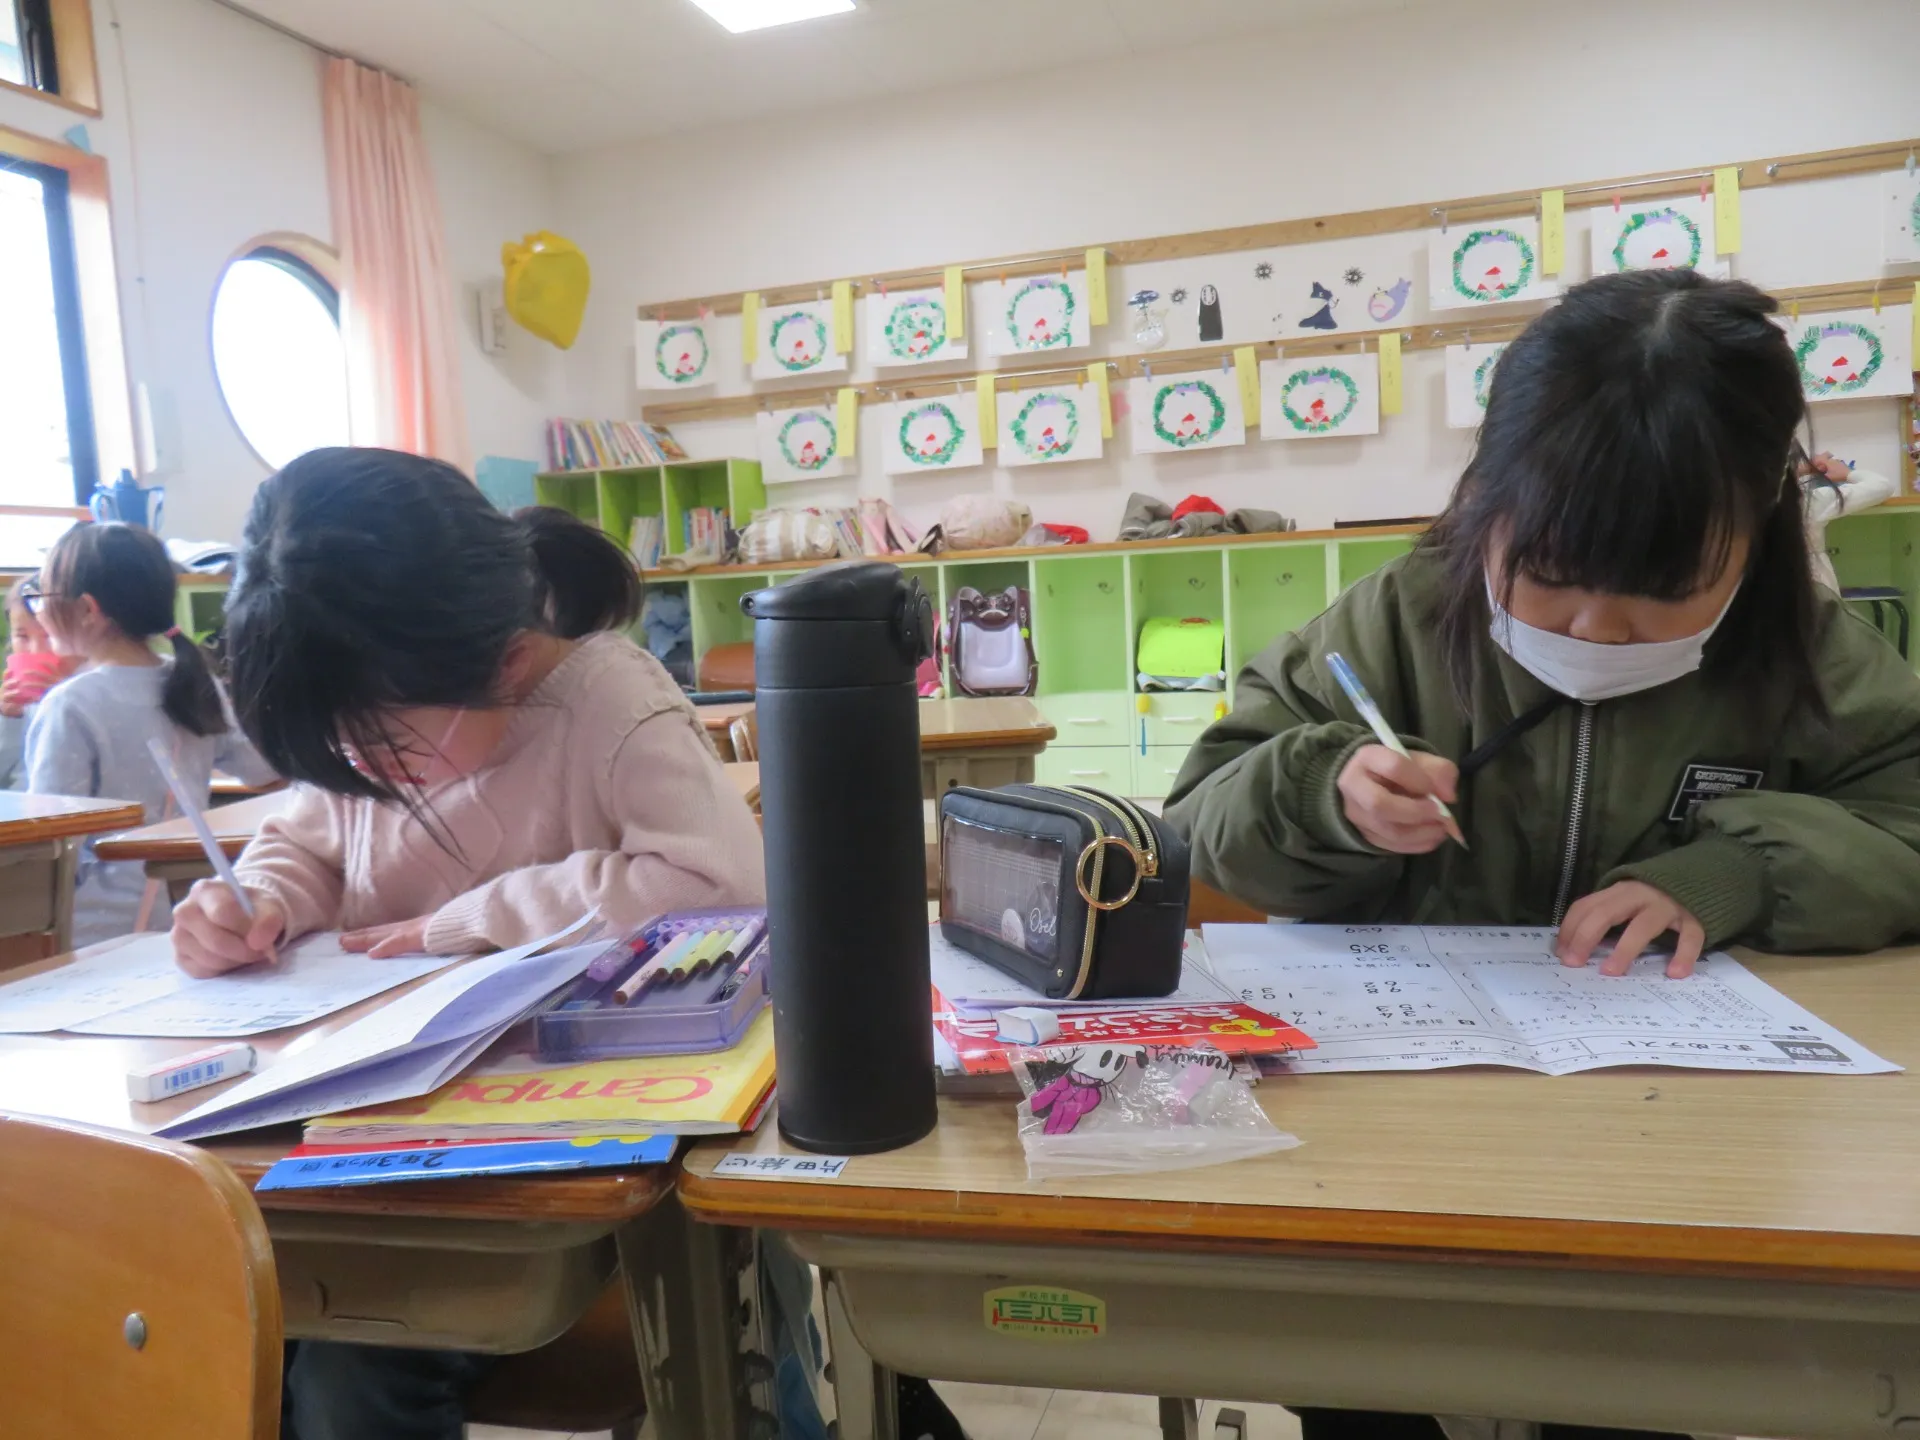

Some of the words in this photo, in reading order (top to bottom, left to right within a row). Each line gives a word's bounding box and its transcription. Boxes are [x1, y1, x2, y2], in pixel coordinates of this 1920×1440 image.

[958, 1006, 1239, 1038] かんじドル
[1618, 1040, 1753, 1053] まとめテスト
